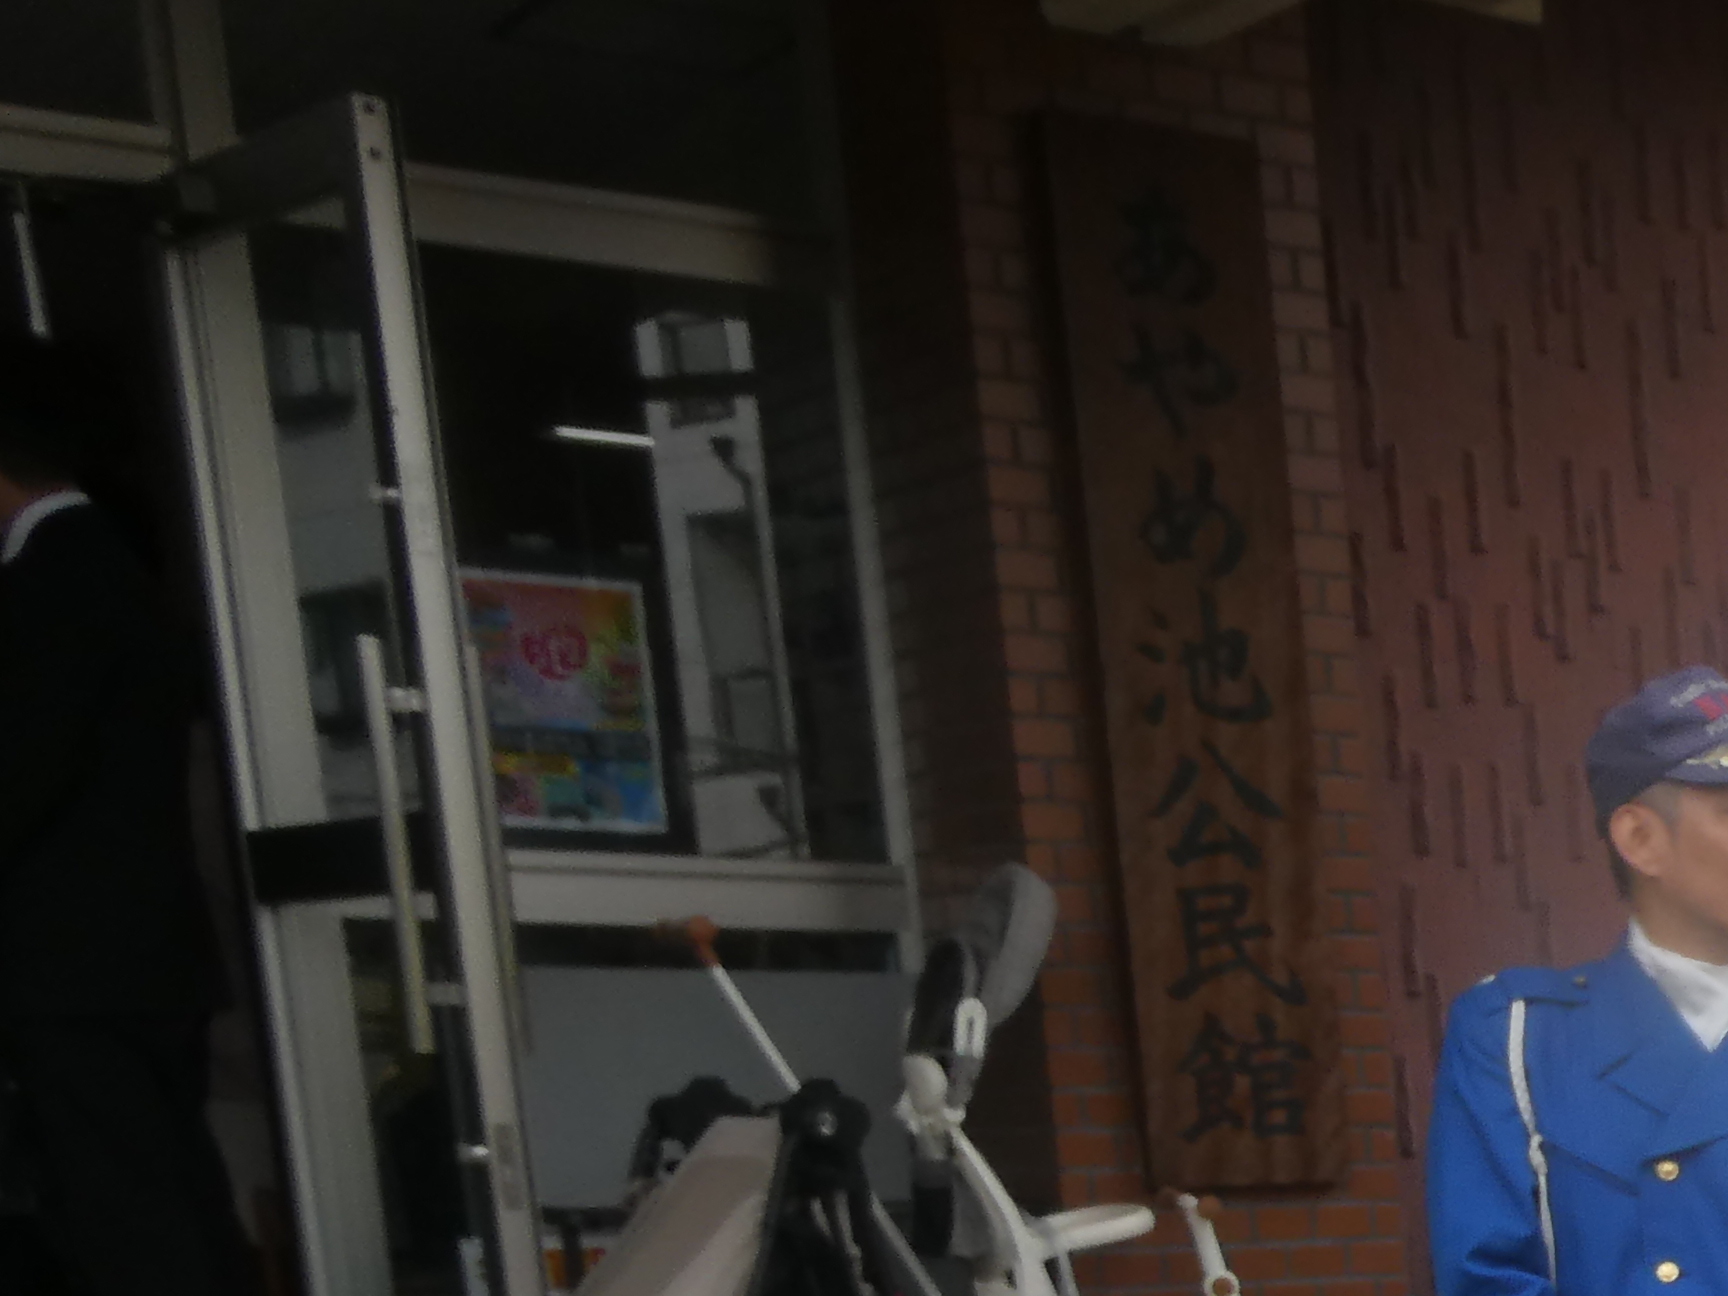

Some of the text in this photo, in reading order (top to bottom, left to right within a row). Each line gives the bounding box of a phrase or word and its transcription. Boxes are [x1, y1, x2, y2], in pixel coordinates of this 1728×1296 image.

[1113, 187, 1315, 1143] あやめ池公民館
